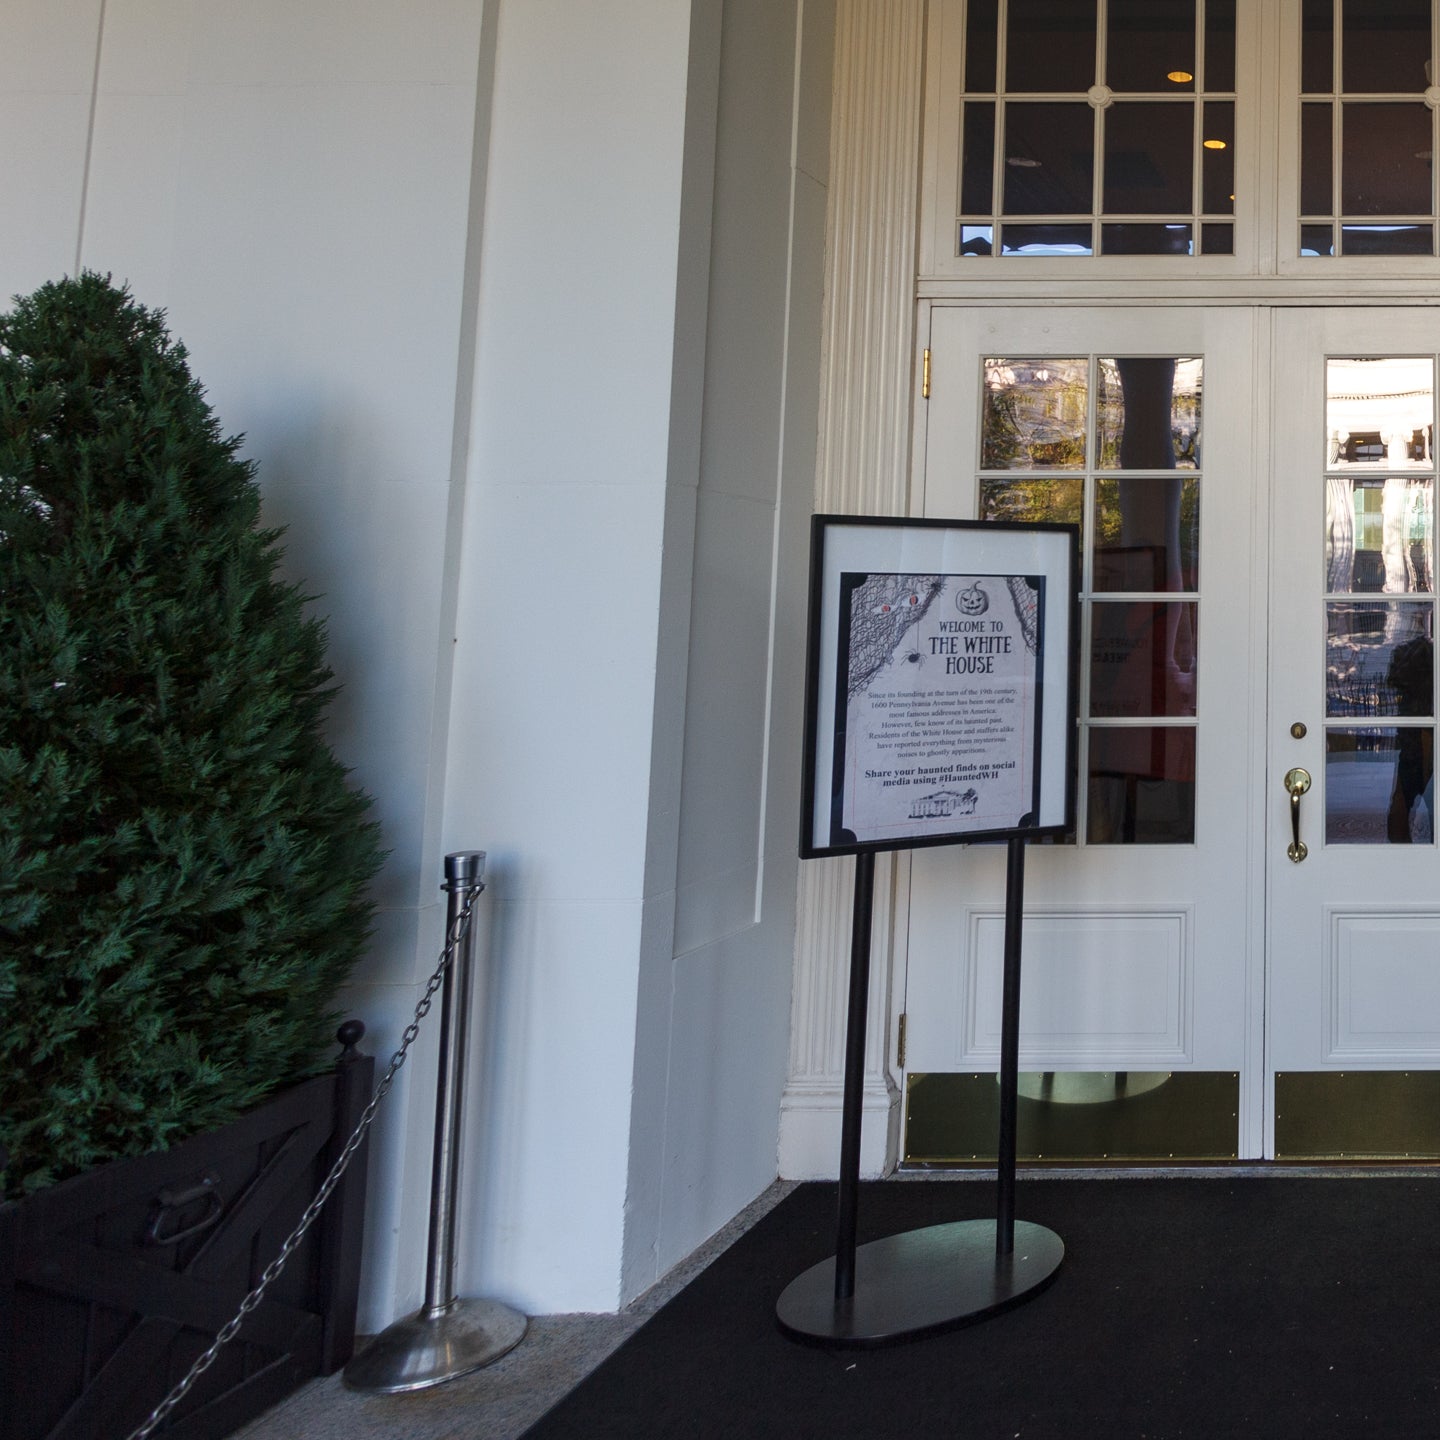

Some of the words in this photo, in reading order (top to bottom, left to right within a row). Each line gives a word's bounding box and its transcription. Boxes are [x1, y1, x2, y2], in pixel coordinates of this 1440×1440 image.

[939, 621, 985, 633] WELCOME
[990, 621, 1004, 632] TO
[928, 637, 959, 654] THE
[964, 636, 1012, 653] WHITE
[946, 656, 994, 674] HOUSE
[888, 701, 931, 709] Pennsylvania
[922, 739, 956, 747] everything
[973, 737, 1007, 745] mysterious
[927, 749, 950, 758] ghostly
[864, 769, 892, 778] Share
[894, 769, 915, 778] your
[918, 765, 954, 775] haunted
[956, 763, 977, 772] finds
[992, 761, 1016, 769] social
[883, 777, 911, 787] media
[913, 776, 937, 785] using
[938, 771, 999, 783] #HauntedWH
